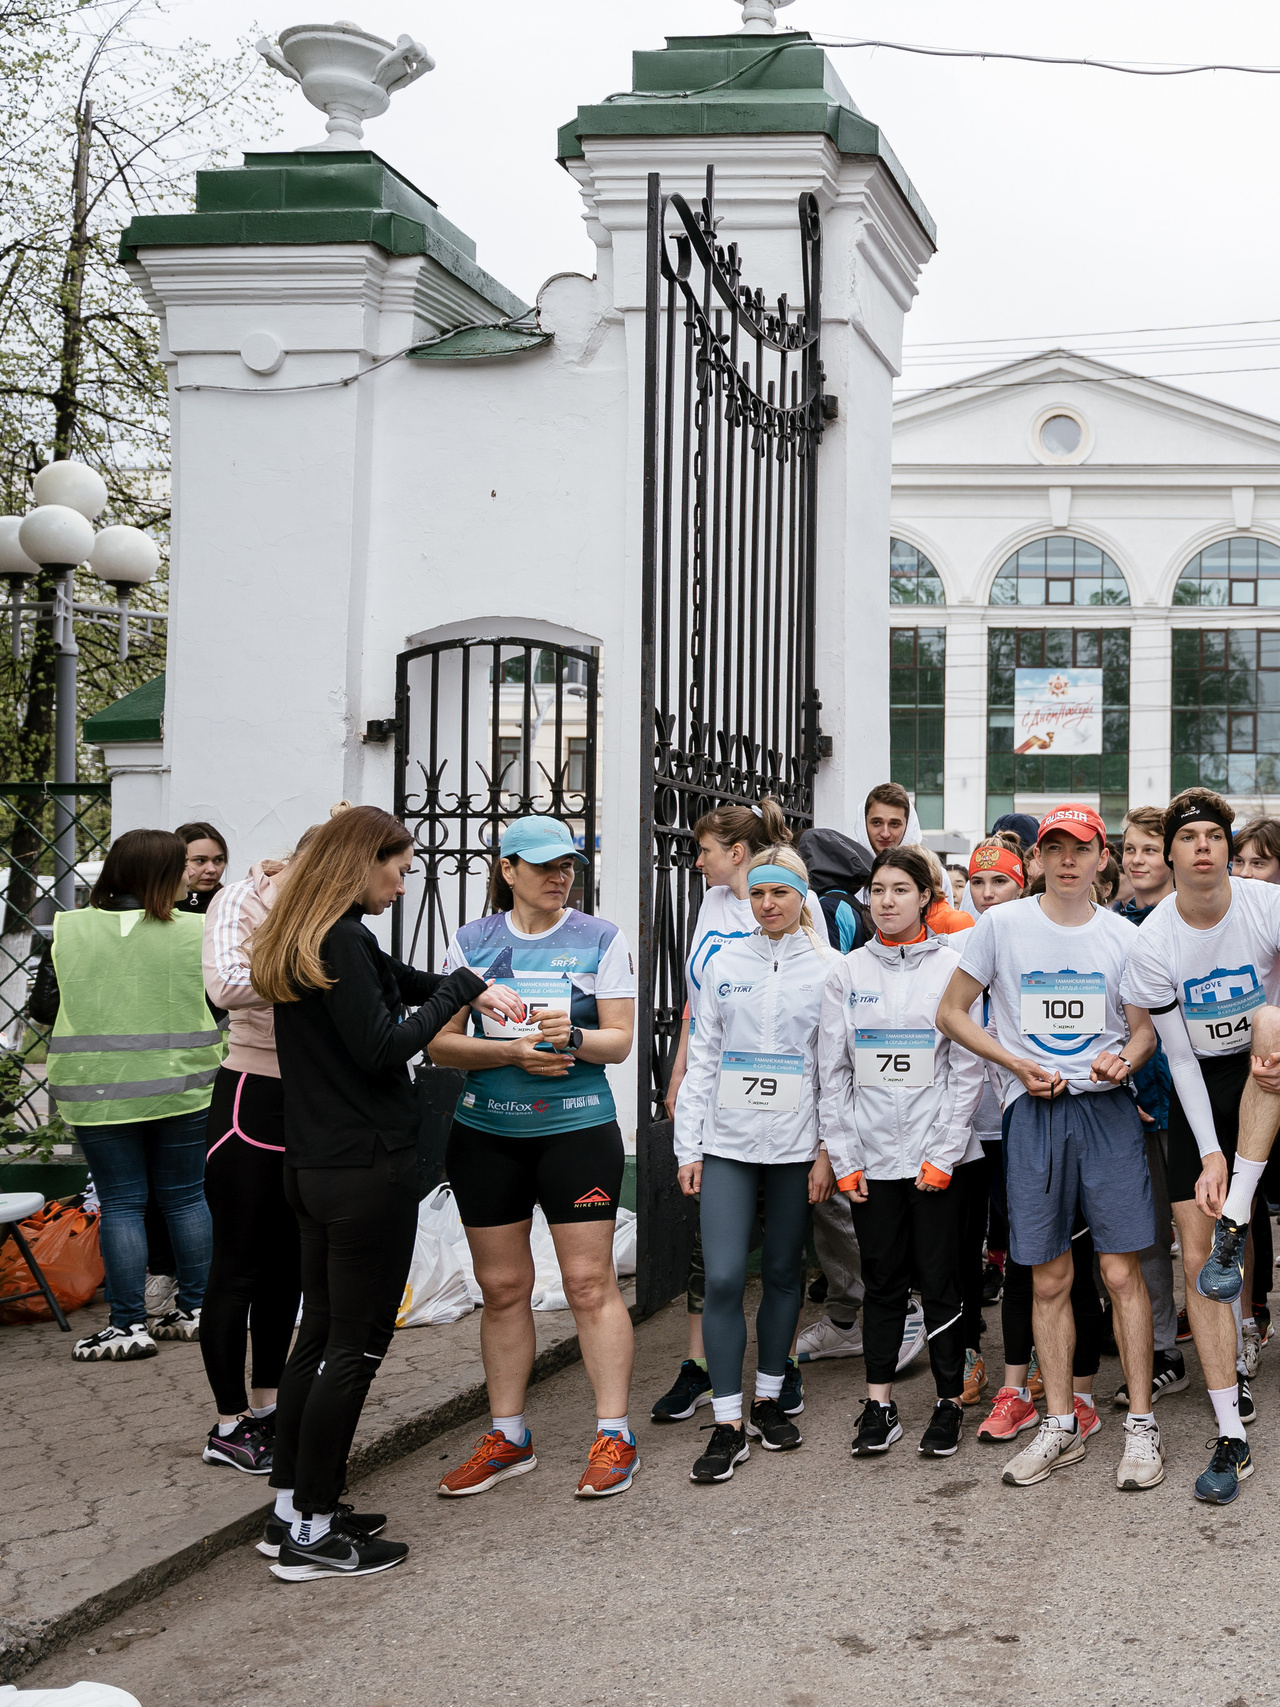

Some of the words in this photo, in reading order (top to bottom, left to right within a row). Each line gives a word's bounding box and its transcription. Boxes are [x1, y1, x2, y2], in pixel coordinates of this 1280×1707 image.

[1022, 710, 1030, 727] С
[1043, 810, 1088, 827] RUSSIA
[551, 959, 568, 967] SRF
[1201, 981, 1222, 992] LOVE
[1042, 1000, 1084, 1019] 100
[1205, 1016, 1251, 1040] 104
[876, 1054, 911, 1072] 76
[742, 1077, 777, 1096] 79
[487, 1099, 532, 1111] RedFox
[297, 1522, 312, 1543] NIKE
